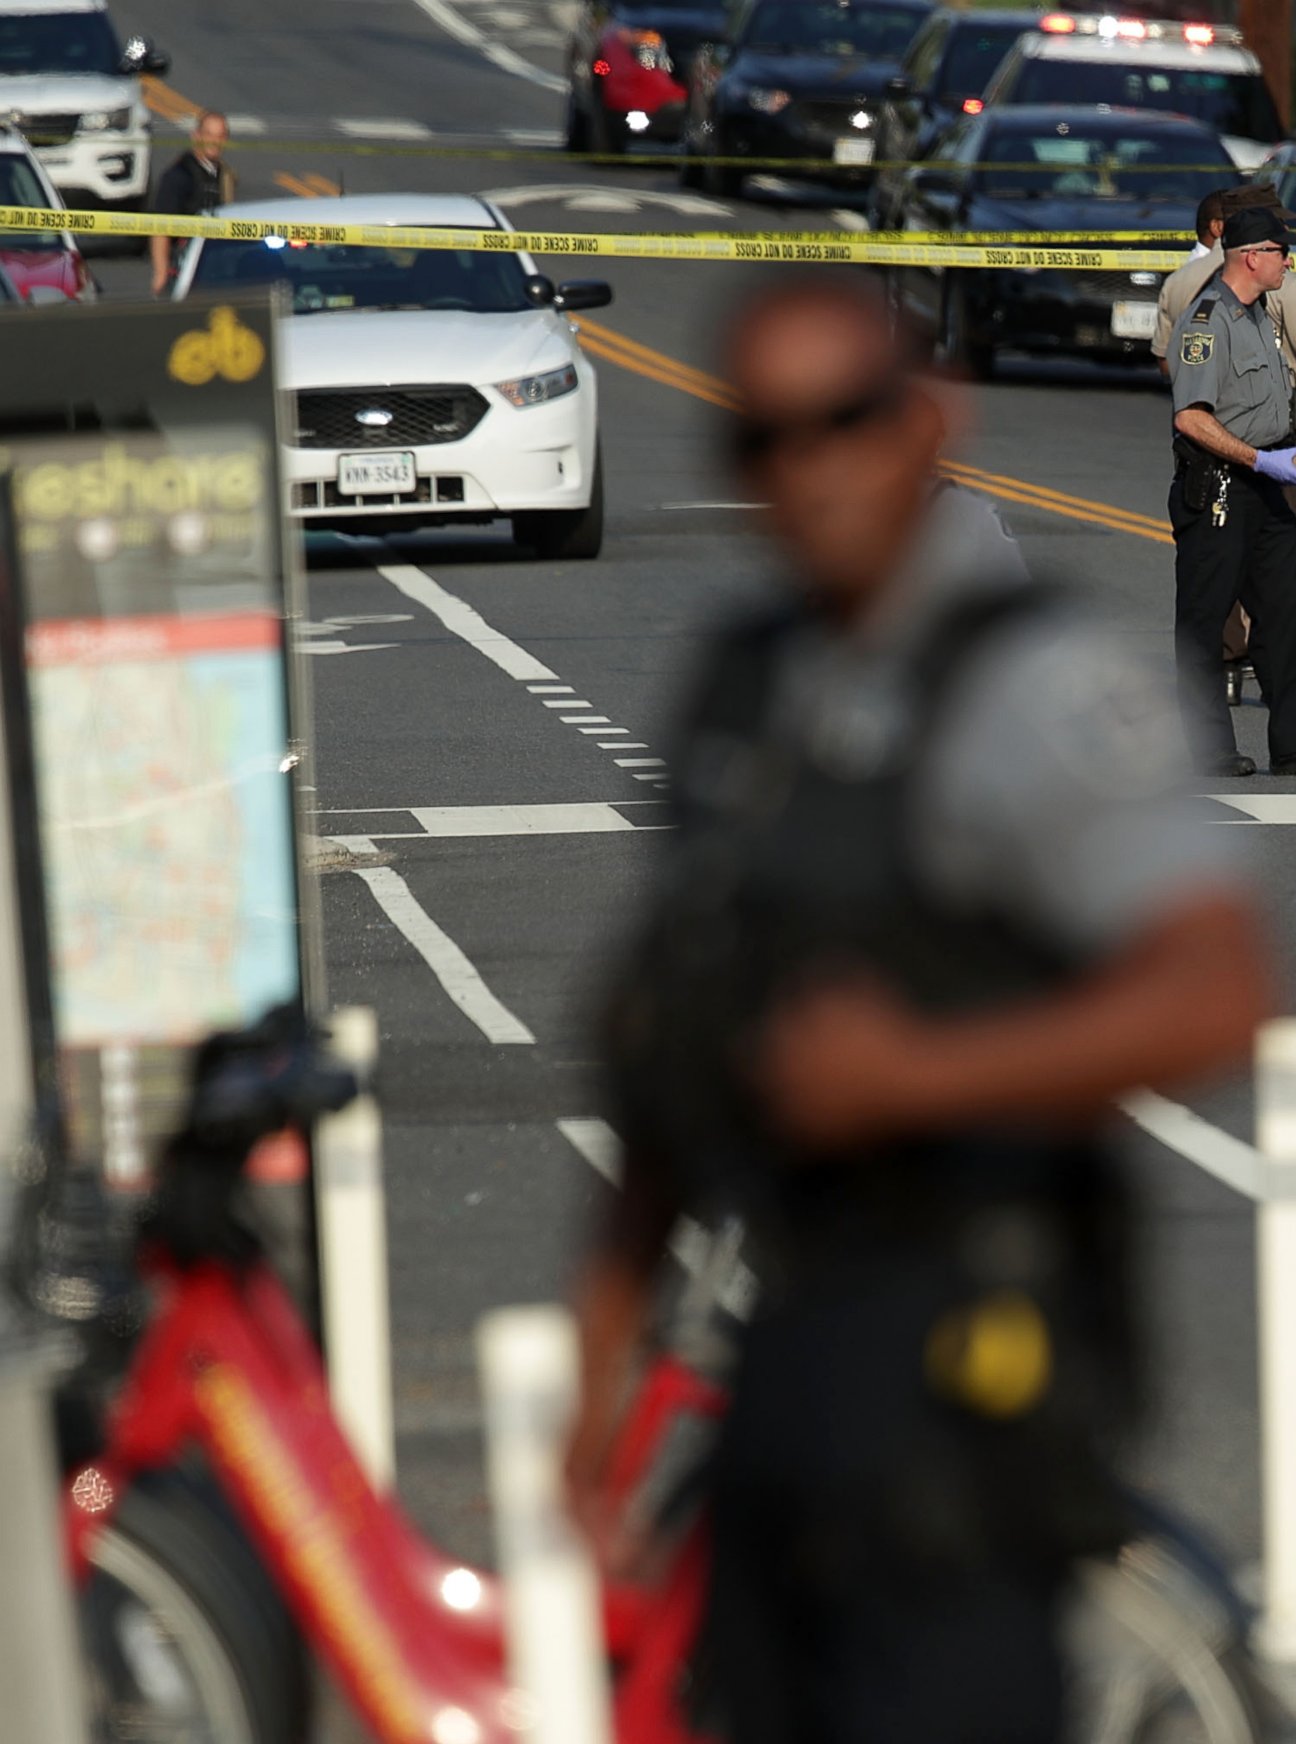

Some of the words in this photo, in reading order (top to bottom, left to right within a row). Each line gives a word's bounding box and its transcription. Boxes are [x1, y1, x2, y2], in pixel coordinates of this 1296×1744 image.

[27, 211, 38, 225] DO
[41, 212, 66, 227] SCENE
[68, 214, 95, 229] CRIME
[231, 222, 258, 238] CROSS
[291, 226, 316, 240] SCENE
[319, 227, 346, 242] CRIME
[483, 234, 510, 249] CROSS
[513, 235, 528, 250] NOT
[531, 236, 542, 250] DO
[544, 236, 570, 251] SCENE
[572, 238, 598, 252] CRIME
[735, 242, 762, 257] CROSS
[764, 243, 780, 259] NOT
[782, 244, 793, 259] DO
[796, 245, 822, 259] SCENE
[824, 246, 851, 260] CRIME
[985, 250, 1013, 264] CROSS
[1015, 251, 1031, 264] NOT
[1033, 251, 1045, 265] DO
[1047, 252, 1073, 265] SCENE
[1075, 253, 1102, 266] CRIME
